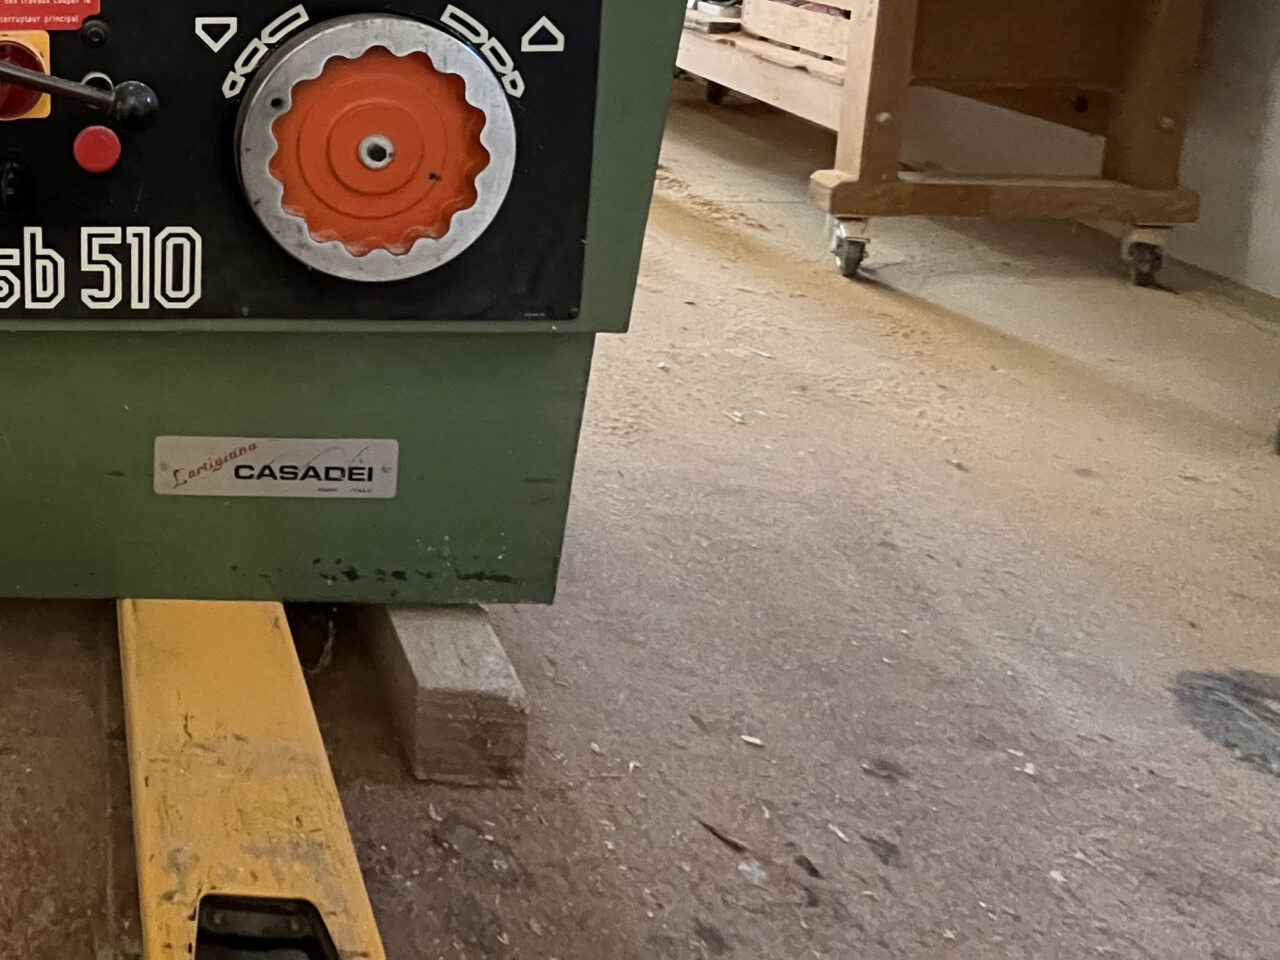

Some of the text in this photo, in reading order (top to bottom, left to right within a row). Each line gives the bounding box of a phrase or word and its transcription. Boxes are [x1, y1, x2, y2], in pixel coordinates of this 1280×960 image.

[44, 14, 79, 25] principal
[80, 226, 202, 309] 510
[233, 464, 374, 482] CASADEI
